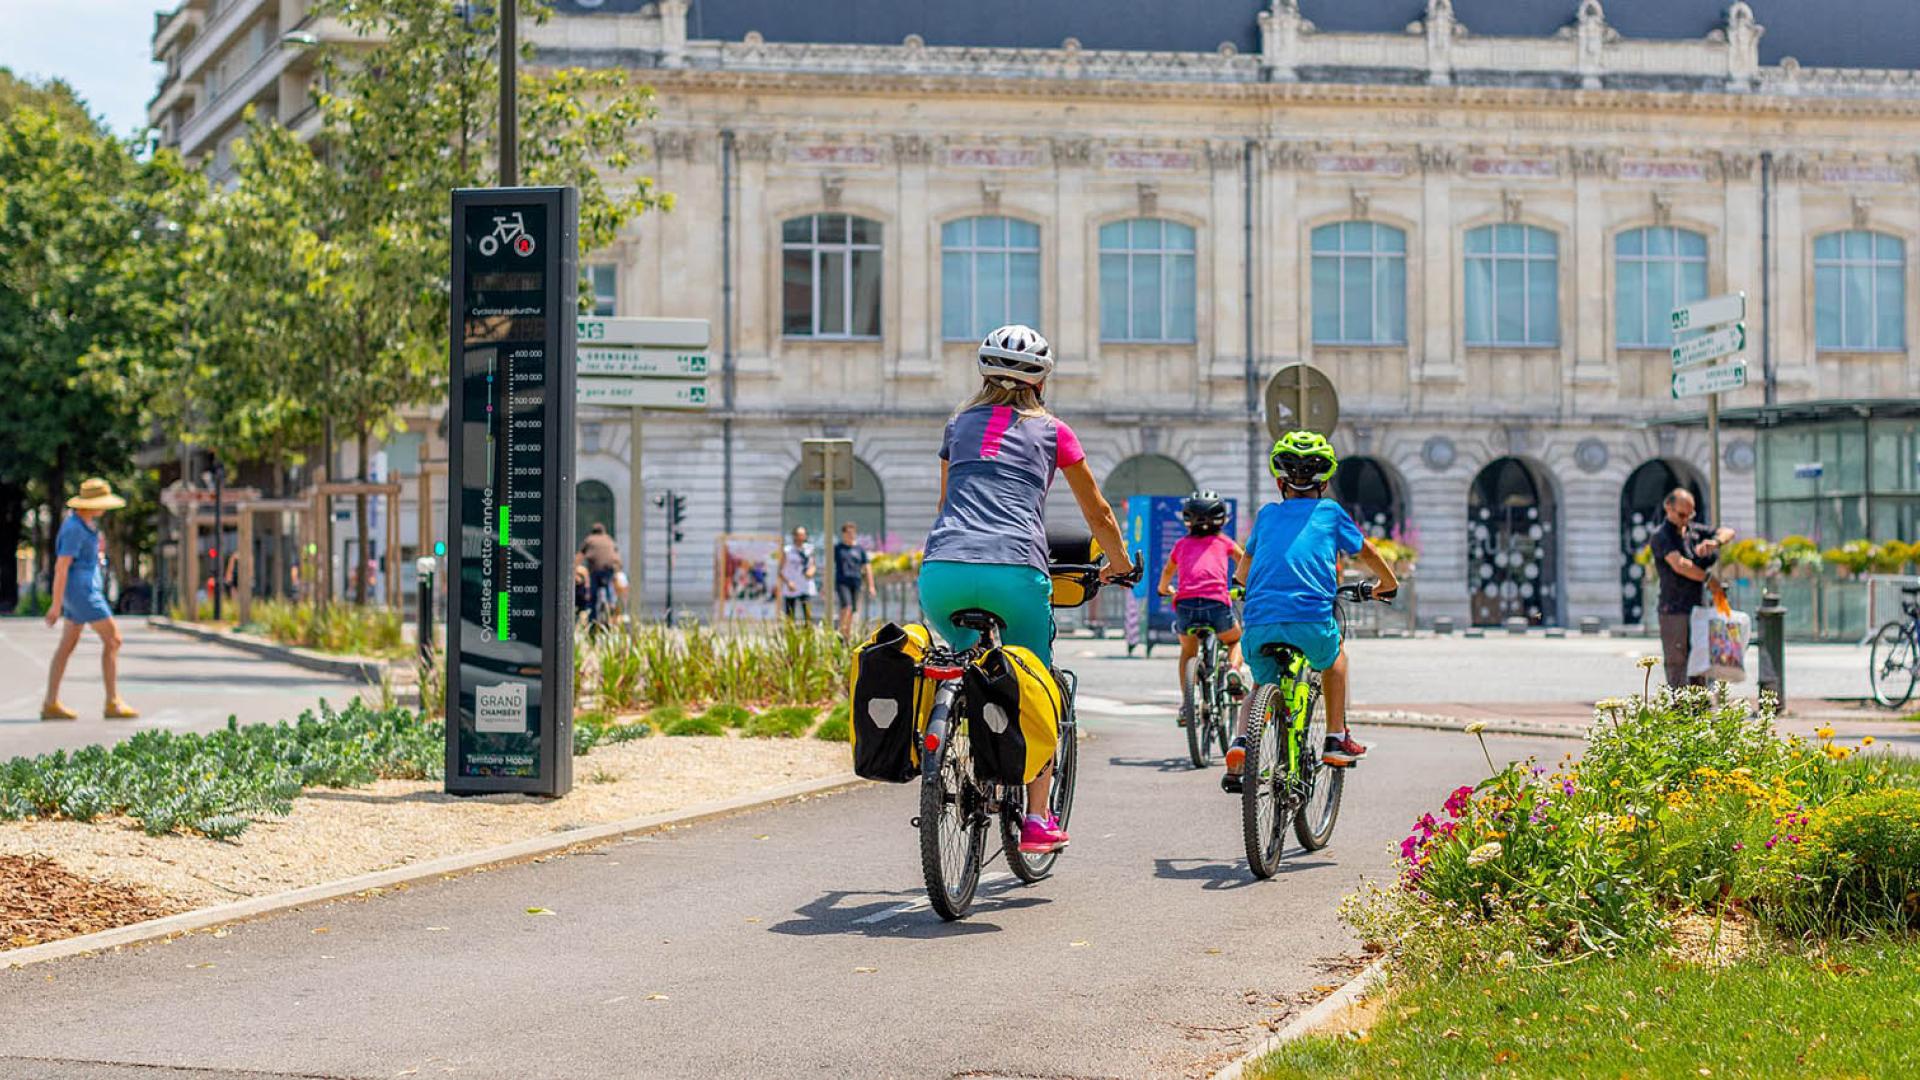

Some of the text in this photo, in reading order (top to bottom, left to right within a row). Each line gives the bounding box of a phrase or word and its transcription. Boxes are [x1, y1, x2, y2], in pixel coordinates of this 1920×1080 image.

[480, 487, 493, 643] Cyclistes cette année
[480, 695, 522, 707] GRAND
[467, 754, 534, 765] Territoire Mobile
